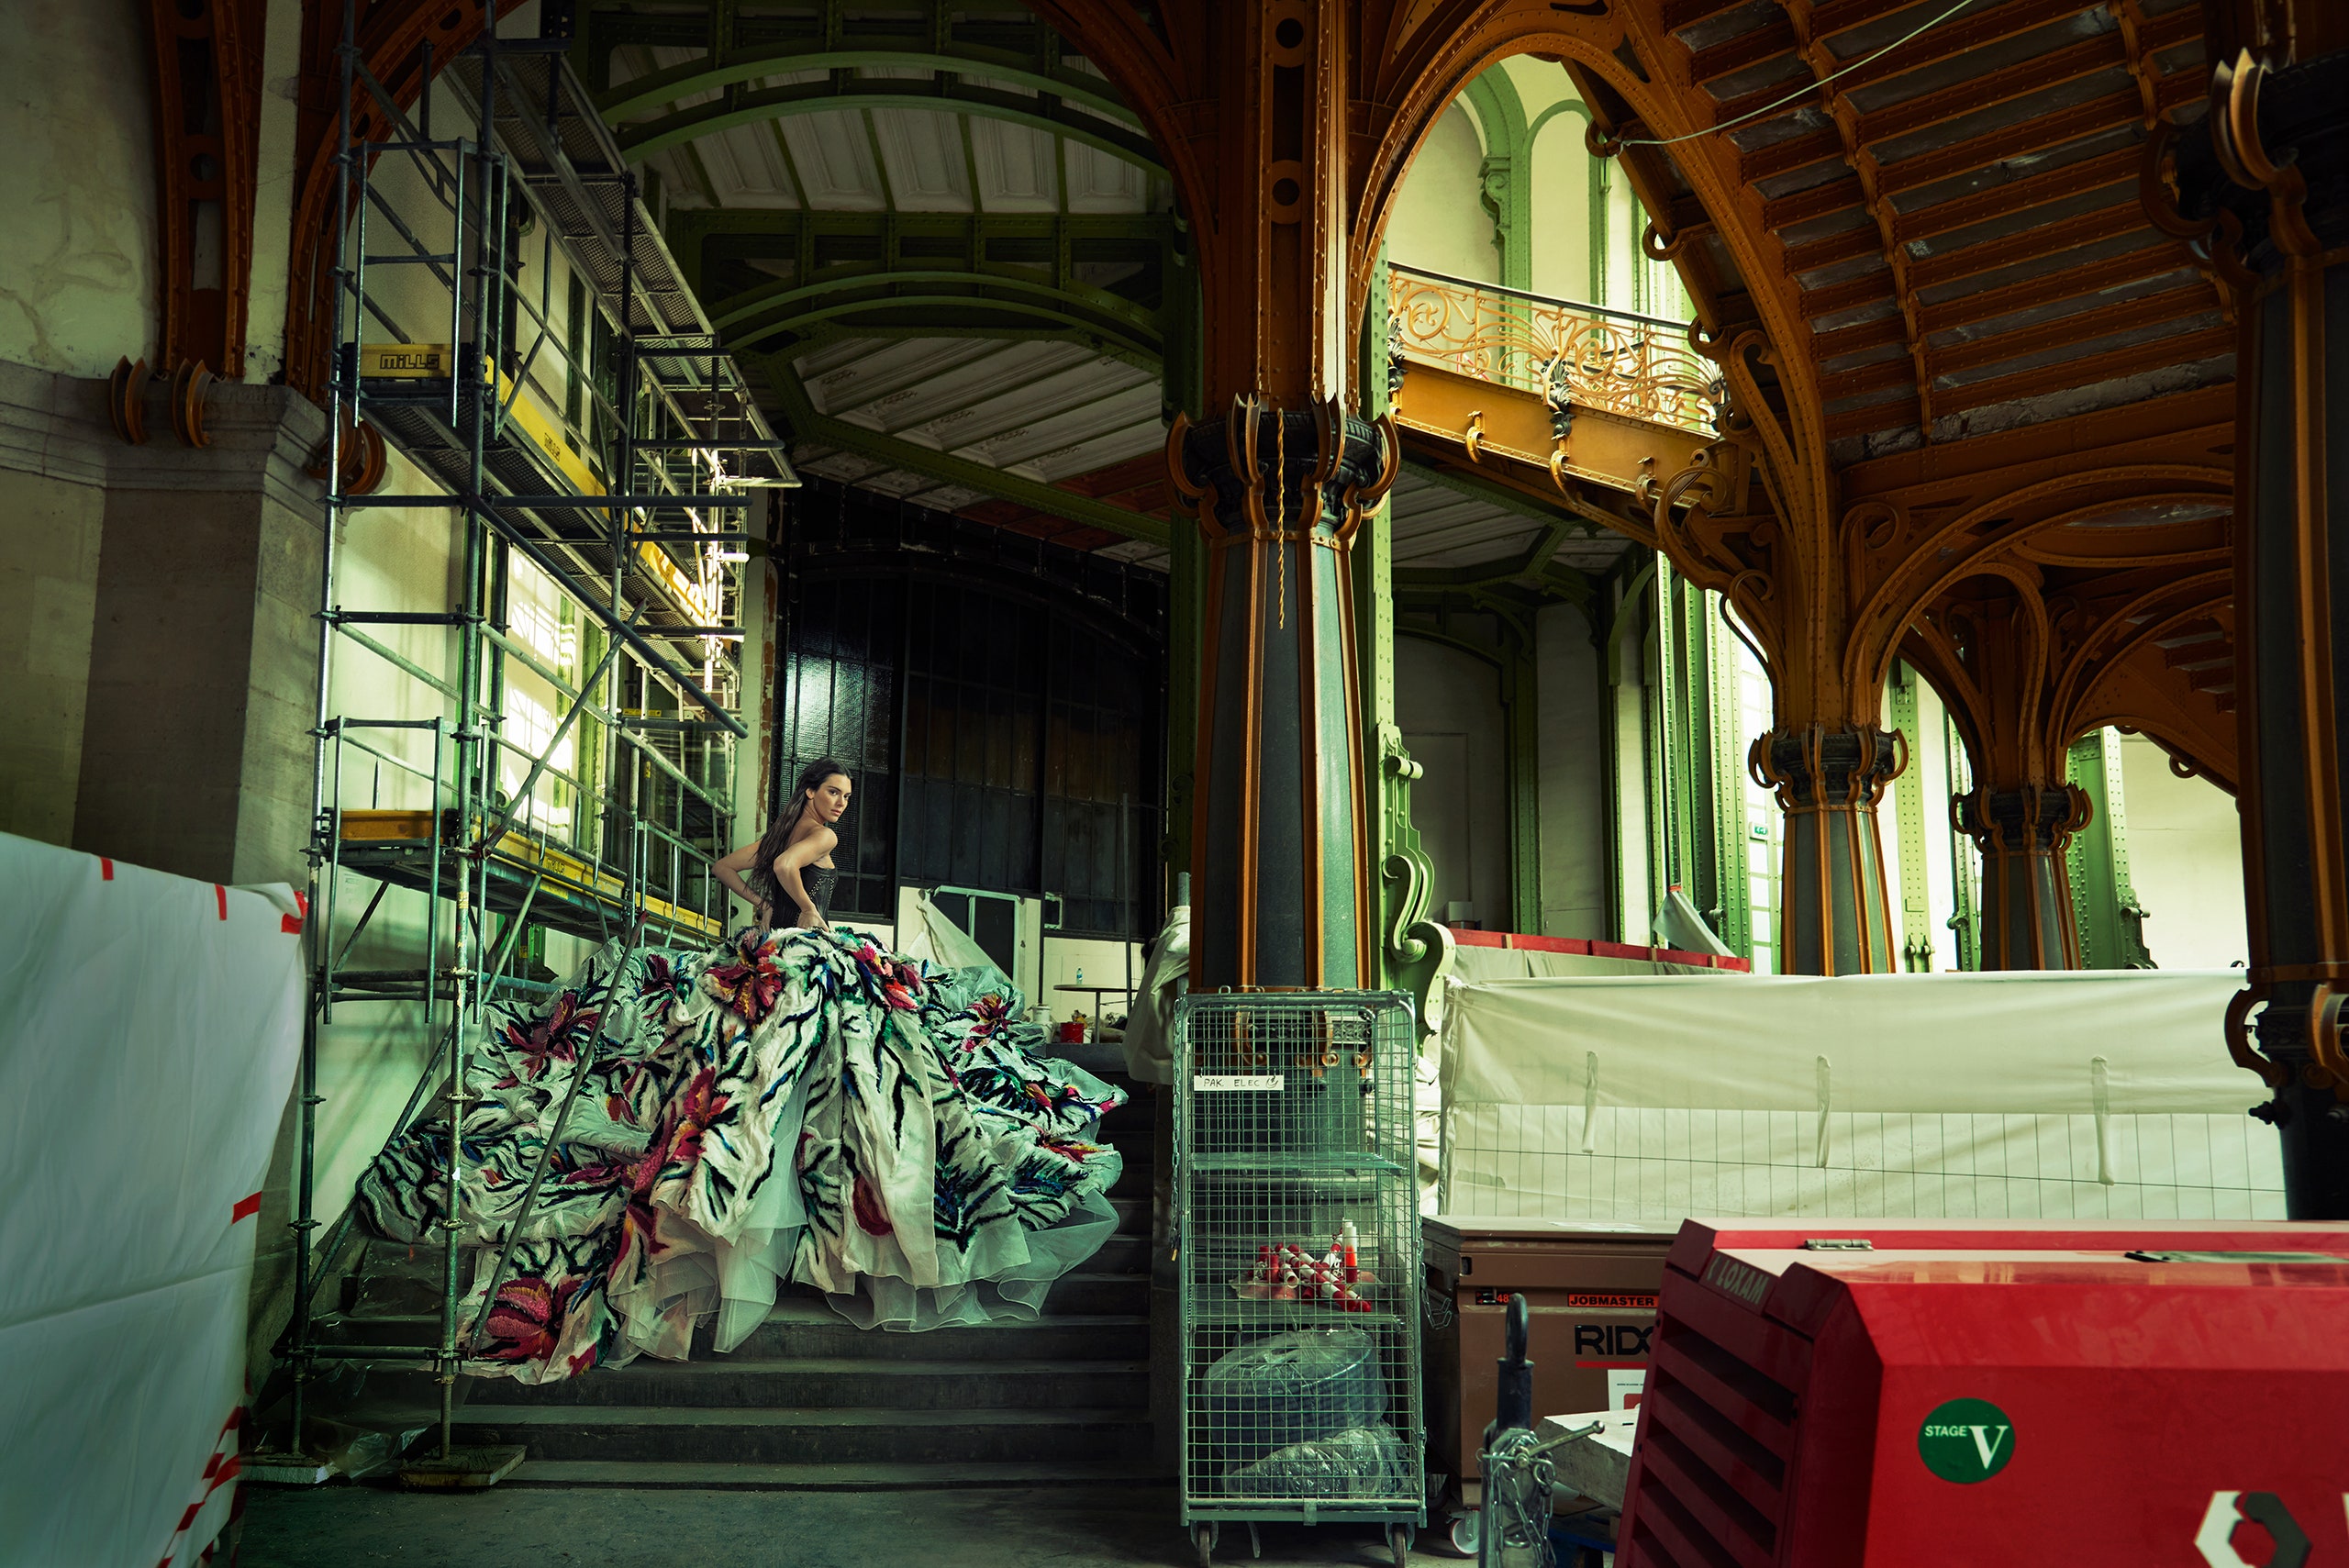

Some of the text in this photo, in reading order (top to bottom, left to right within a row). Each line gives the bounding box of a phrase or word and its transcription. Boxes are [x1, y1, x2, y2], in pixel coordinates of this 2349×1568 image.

[1234, 1078, 1260, 1087] ELEC
[1716, 1260, 1769, 1305] LOXAM
[1571, 1296, 1654, 1306] JOBMASTER
[1924, 1425, 2009, 1470] STAGE V
